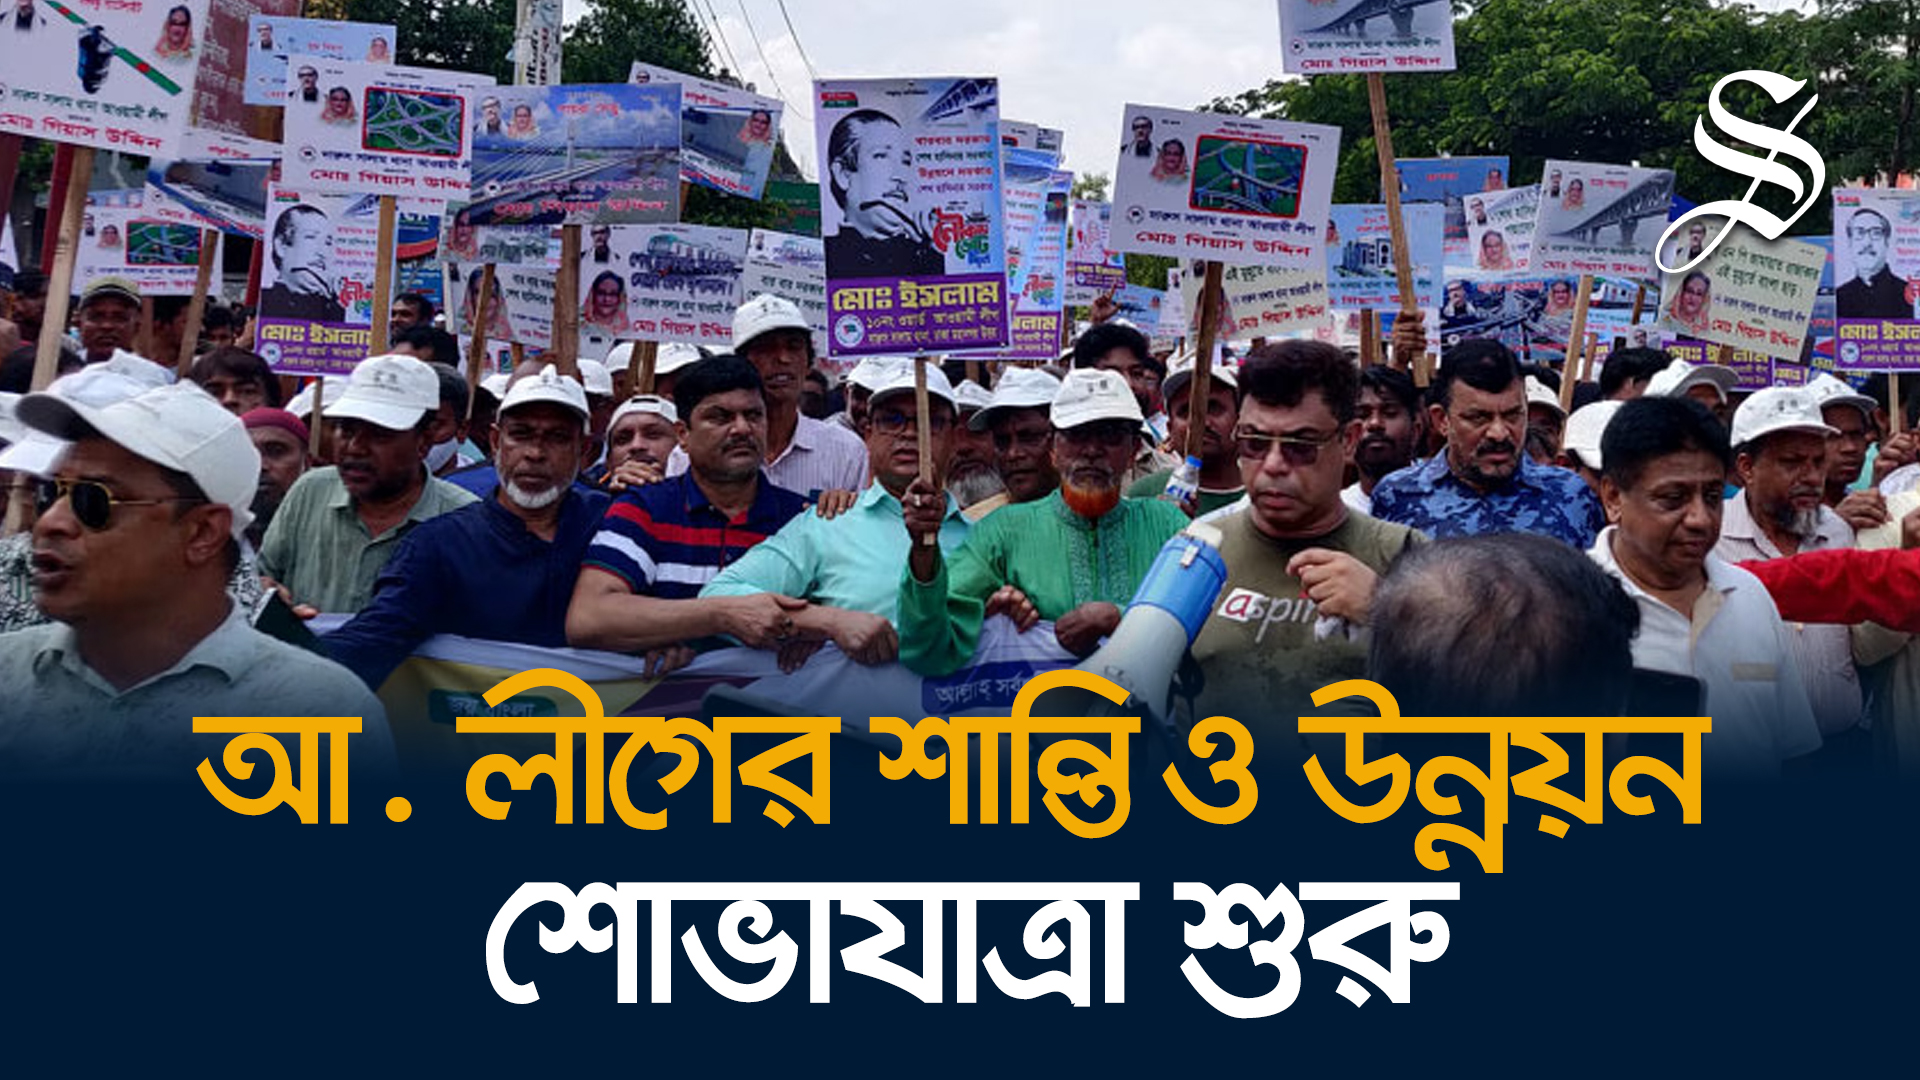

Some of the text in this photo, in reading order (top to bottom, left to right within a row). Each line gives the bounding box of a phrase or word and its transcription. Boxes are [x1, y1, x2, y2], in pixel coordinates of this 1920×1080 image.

[1300, 55, 1442, 70] মোঃ গিয়াস উদ্দিন
[42, 116, 98, 139] গিয়াস
[310, 168, 349, 182] মোঃ
[358, 170, 415, 186] গিয়াস
[1135, 230, 1312, 257] মোঃ গিয়াস উদ্দিন
[832, 286, 894, 312] মোঃ
[898, 280, 1000, 309] ইসলাম
[261, 321, 372, 346] মোঃ ইসলা
[633, 317, 733, 340] মোঃ গিয়াস উদ্দিন
[1839, 323, 1879, 340] মোঃ
[1882, 320, 1920, 340] ইসল
